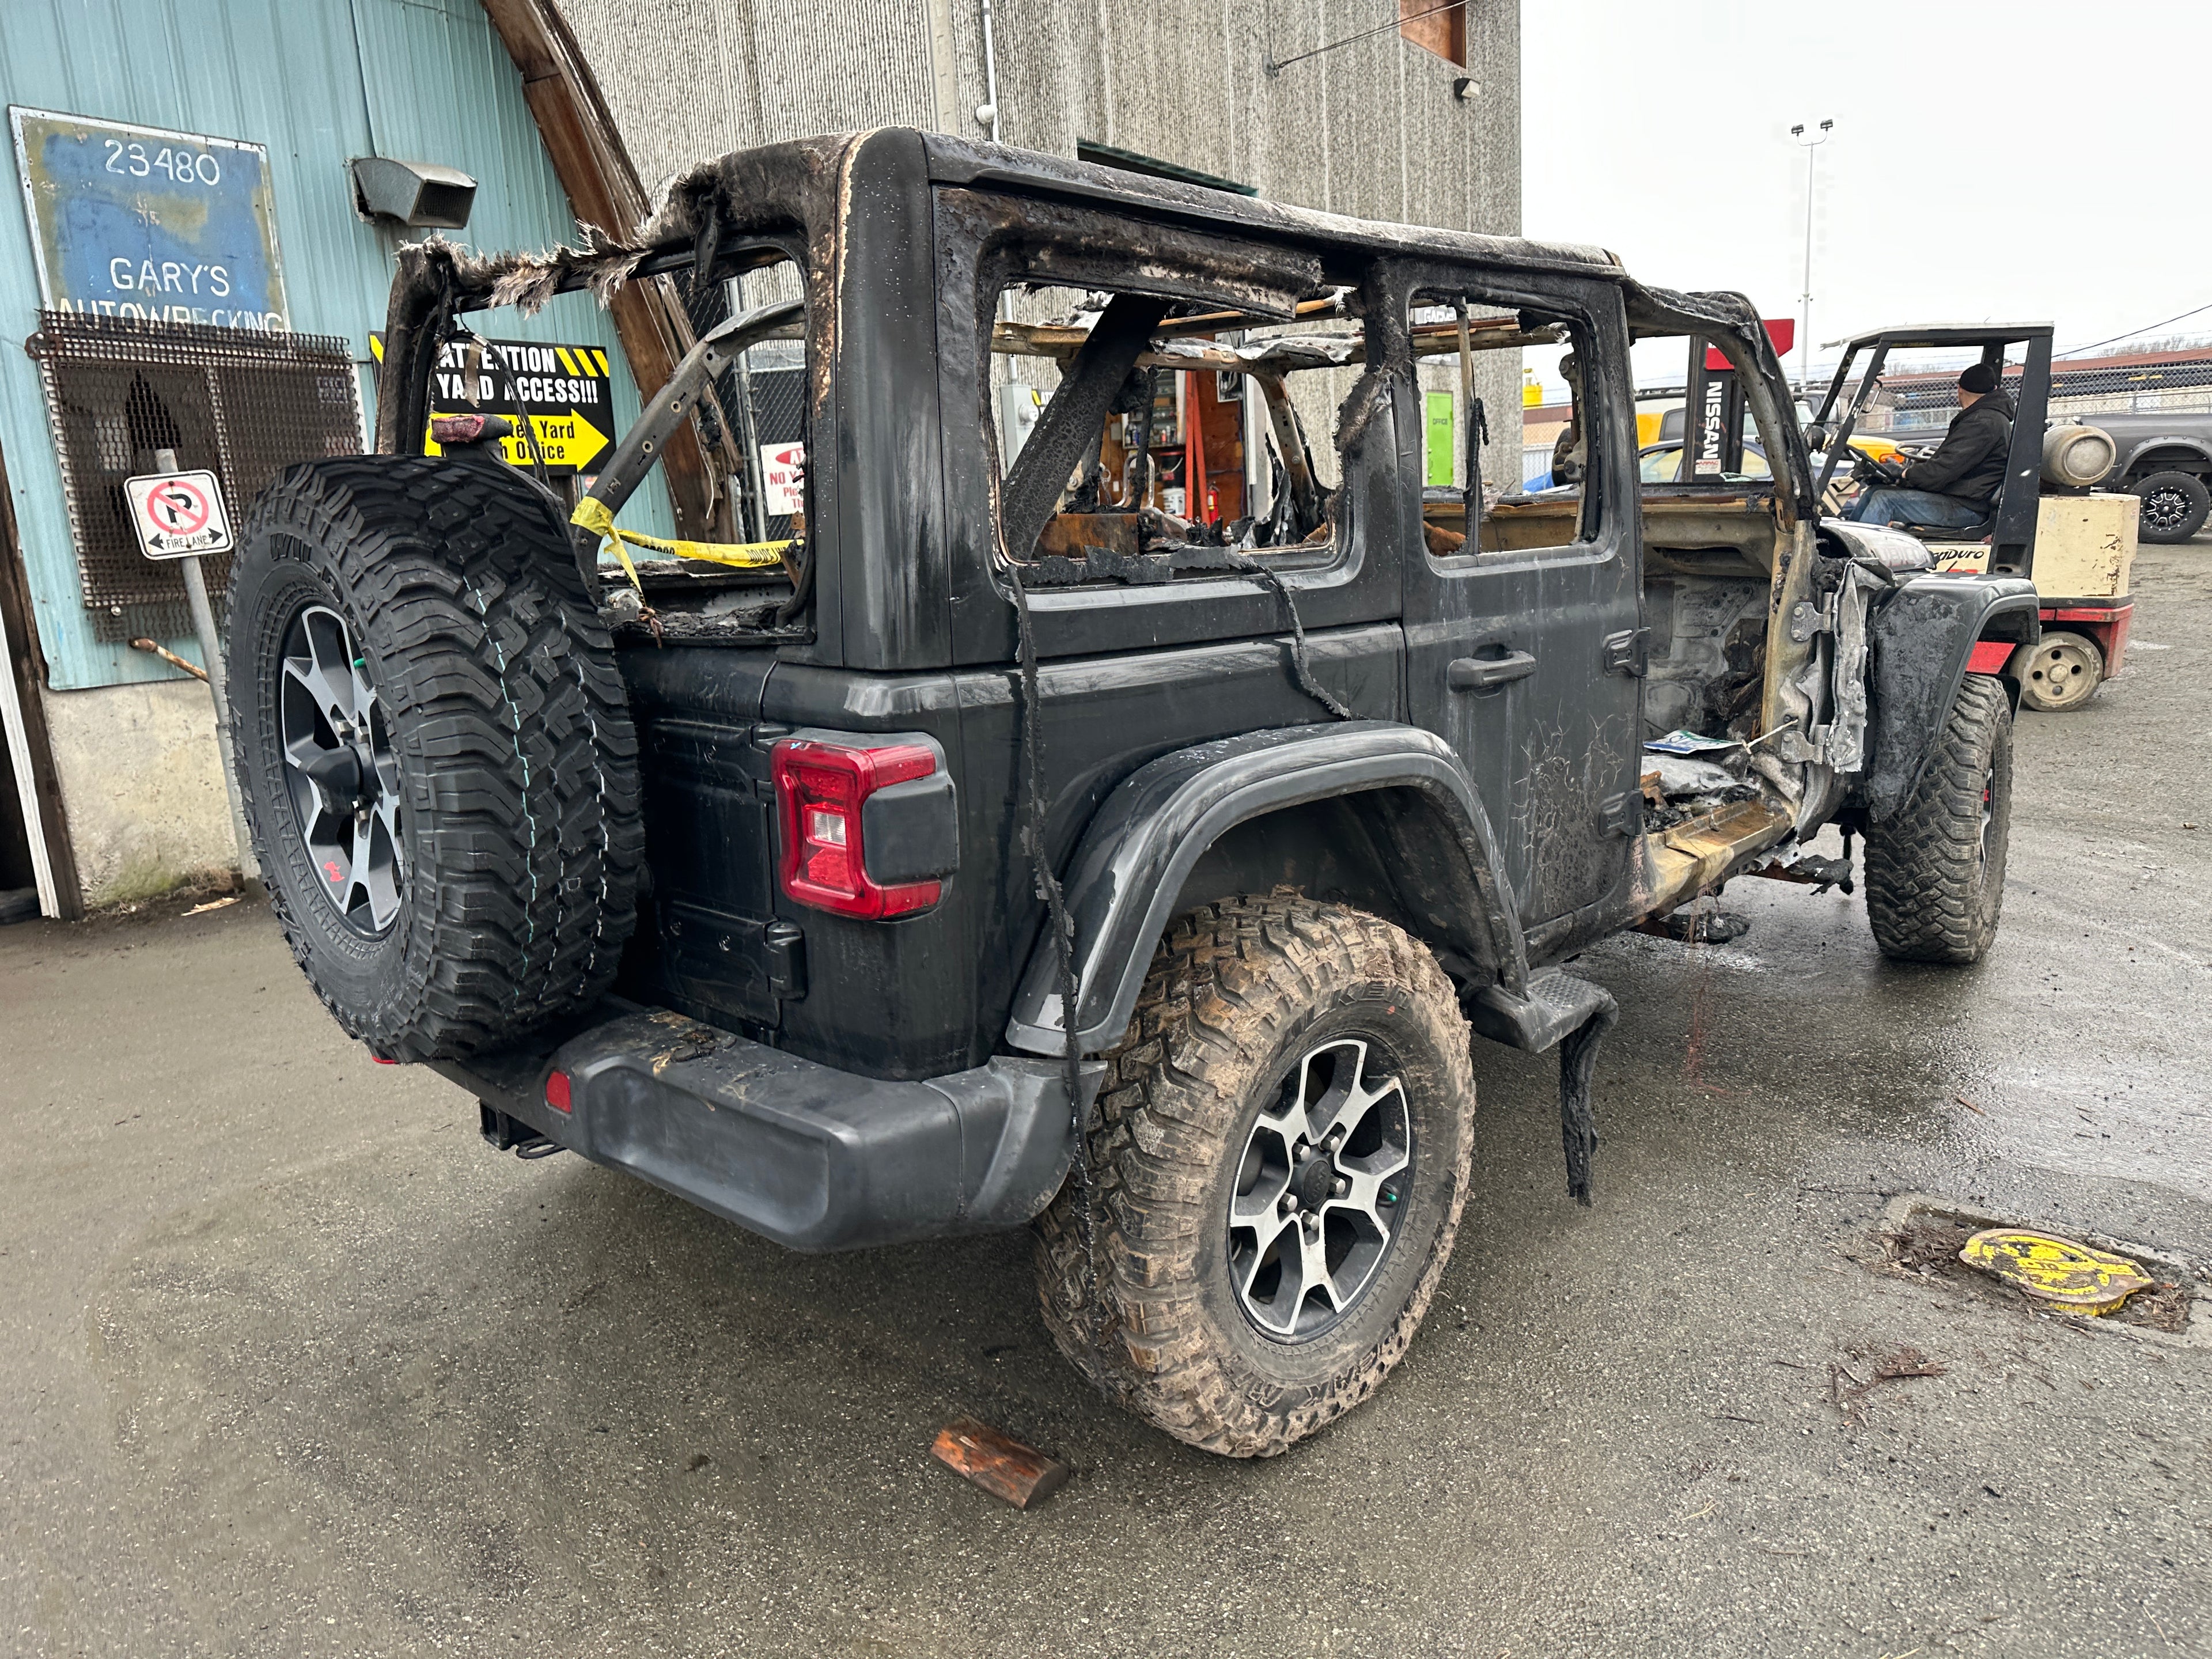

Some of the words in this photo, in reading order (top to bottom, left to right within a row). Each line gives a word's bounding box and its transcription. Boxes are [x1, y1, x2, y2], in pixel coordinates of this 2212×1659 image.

[105, 139, 220, 185] 23480
[110, 257, 230, 297] GARY'S
[440, 342, 556, 373] ATENTION
[436, 373, 494, 400] YAD
[539, 420, 575, 439] Yard
[1703, 381, 1722, 459] NISSAN
[770, 471, 786, 485] NO
[166, 537, 185, 549] FIRE
